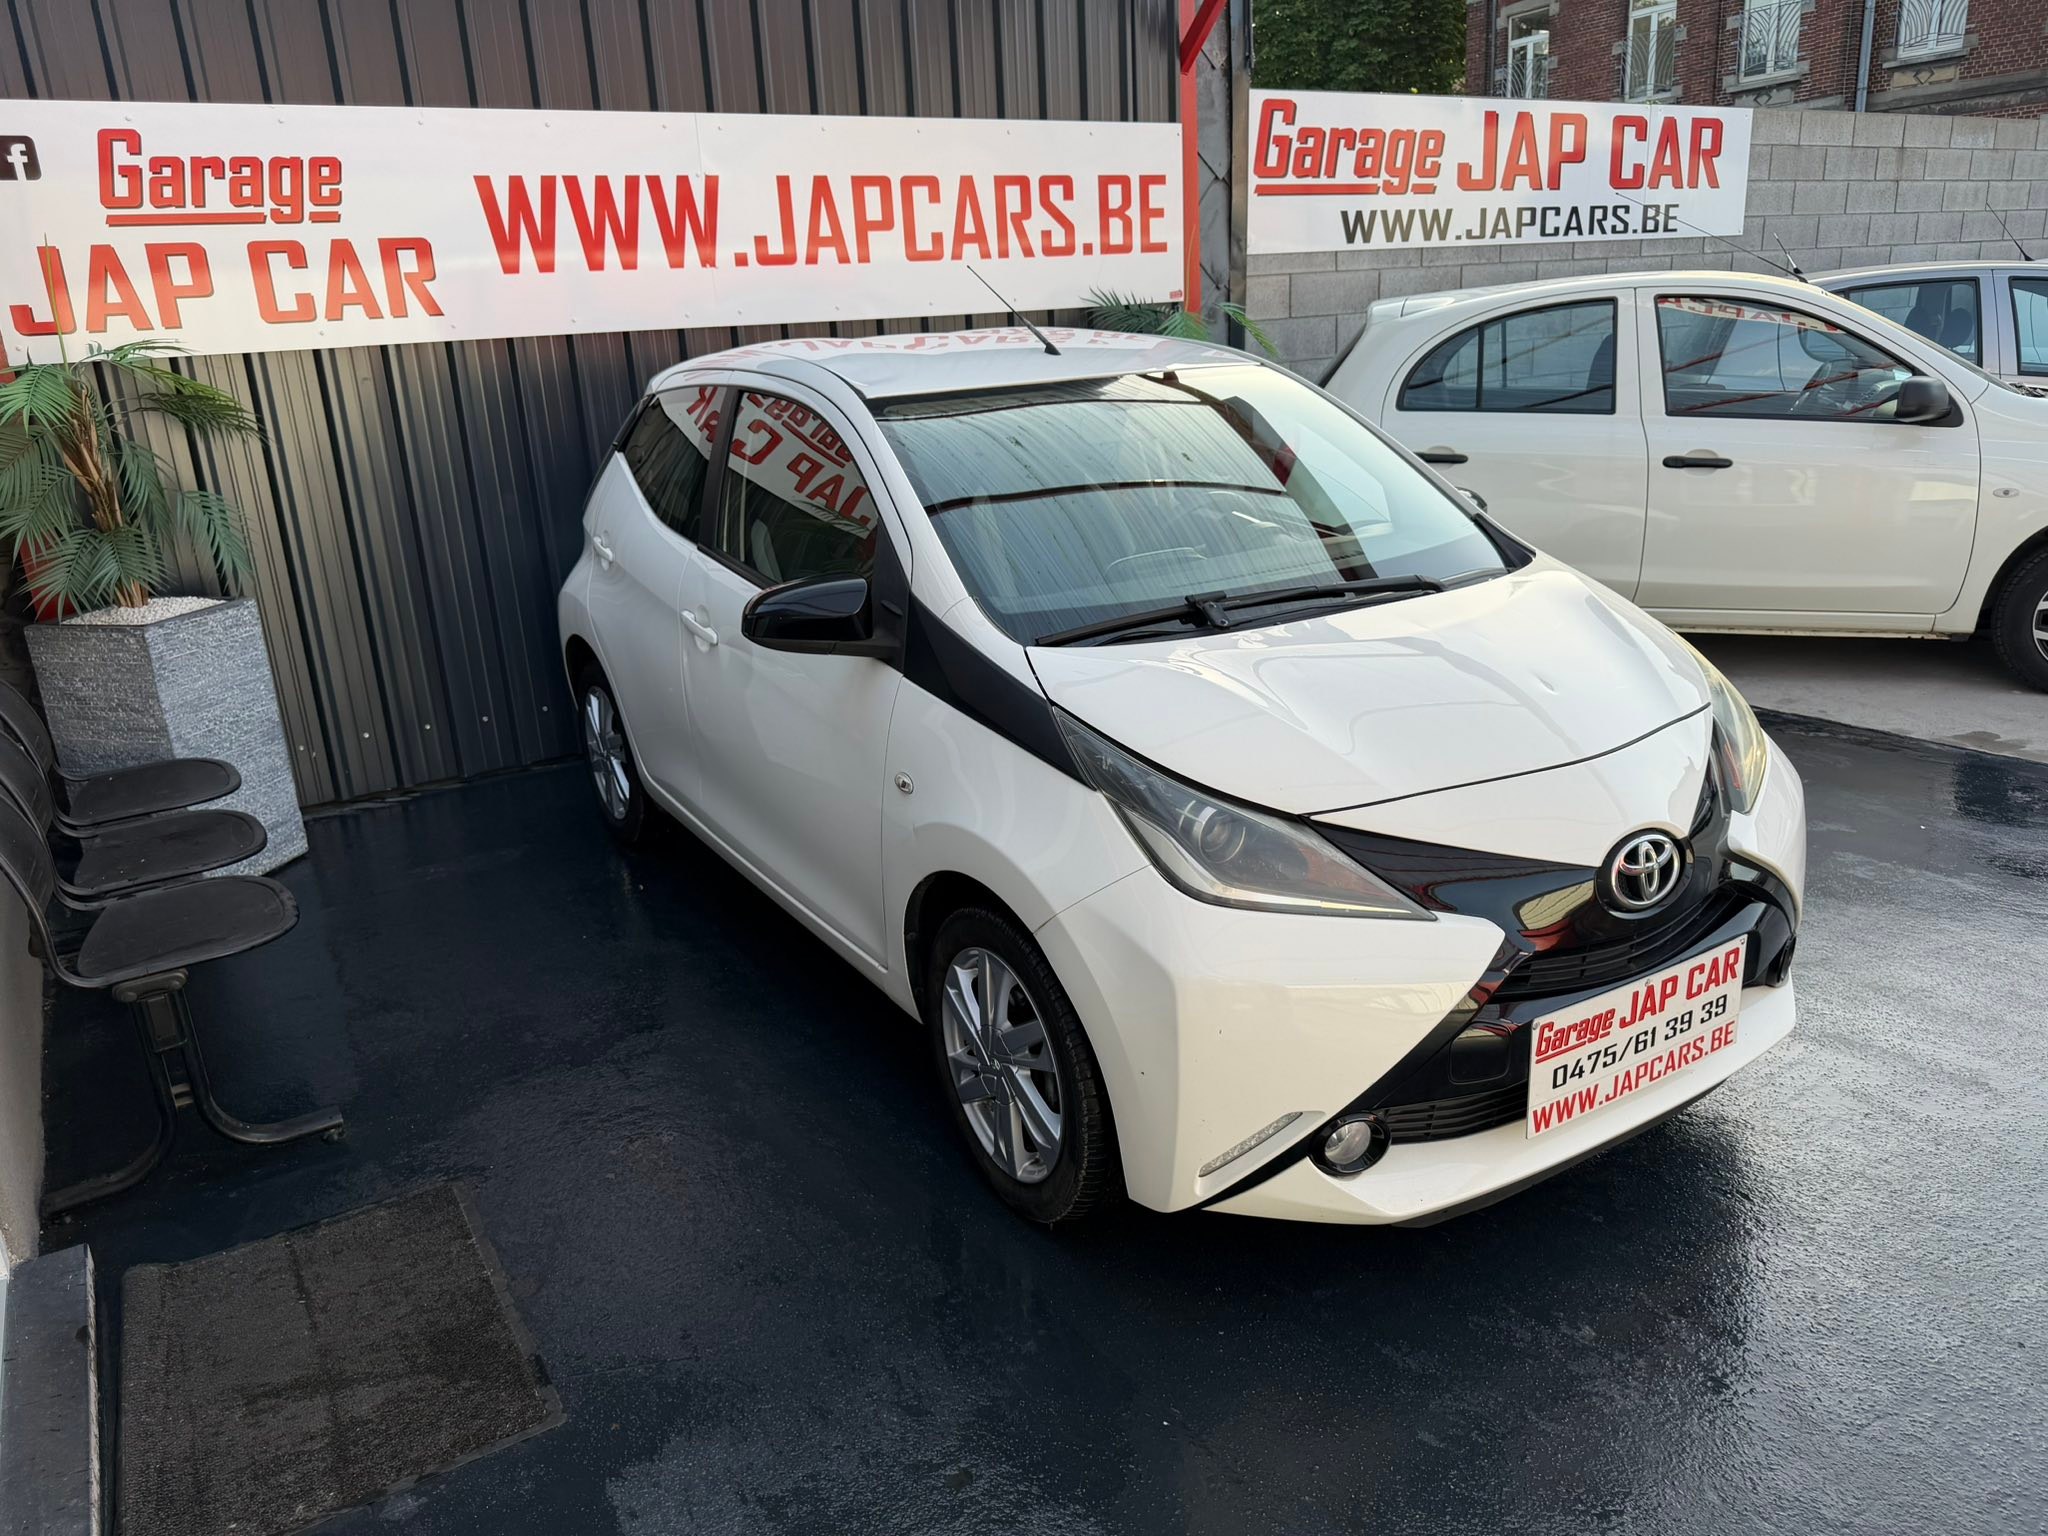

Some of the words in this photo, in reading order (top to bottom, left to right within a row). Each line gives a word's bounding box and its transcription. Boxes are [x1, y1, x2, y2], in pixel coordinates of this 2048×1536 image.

[98, 128, 342, 225] Garage
[1253, 98, 1445, 195] Garage
[1457, 110, 1587, 191] JAP
[1608, 114, 1723, 190] CAR
[473, 174, 1168, 273] WWW.JAPCARS.BE
[1340, 203, 1680, 244] WWW.JAPCARS.BE
[9, 242, 214, 336] JAP
[247, 237, 445, 324] CAR
[1535, 1007, 1616, 1060] Garage
[1619, 974, 1679, 1029] JAP
[1686, 947, 1741, 1000] CAR
[1552, 1025, 1657, 1089] 0475/61
[1664, 1010, 1693, 1041] 39
[1700, 994, 1728, 1025] 39
[1532, 1020, 1736, 1133] WWW.JAPCARS.BE
